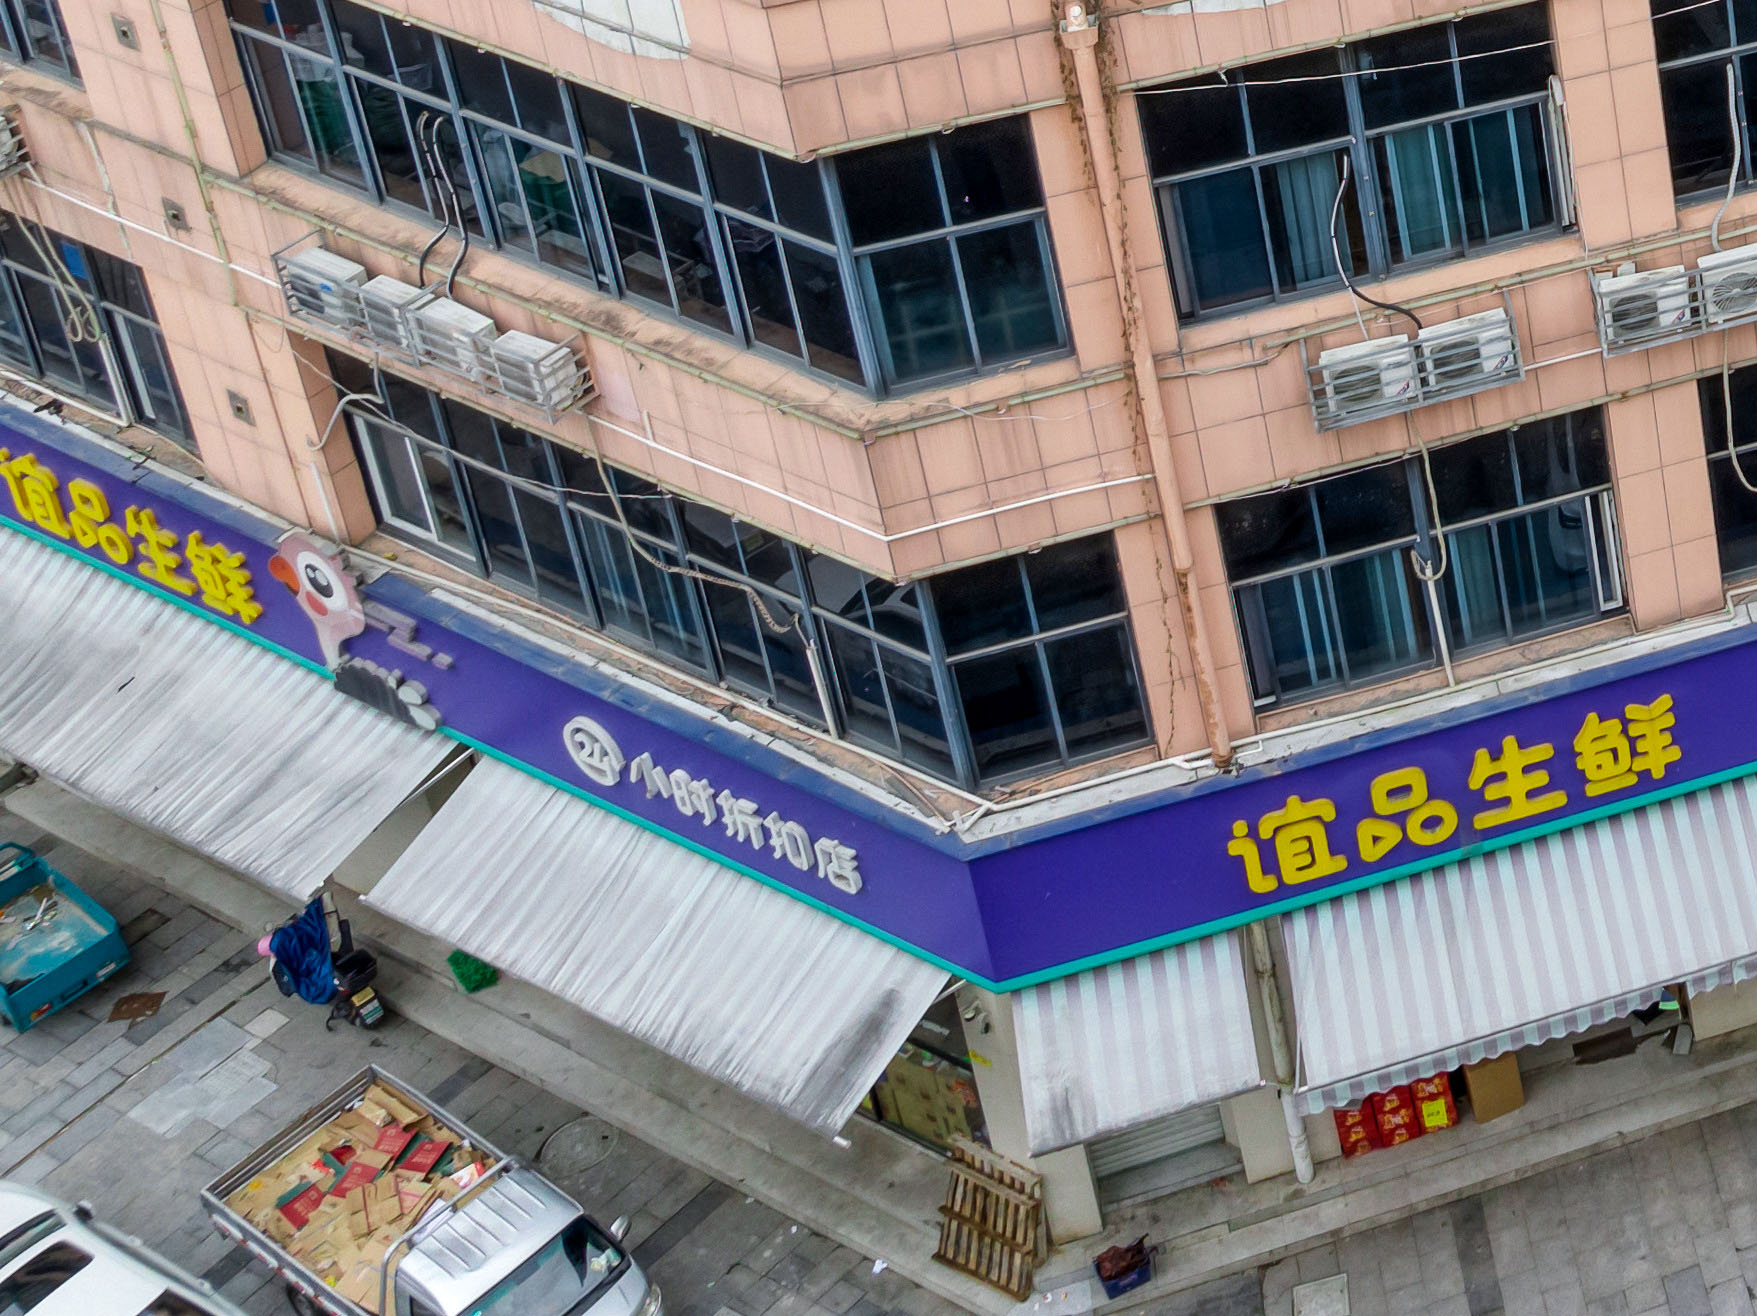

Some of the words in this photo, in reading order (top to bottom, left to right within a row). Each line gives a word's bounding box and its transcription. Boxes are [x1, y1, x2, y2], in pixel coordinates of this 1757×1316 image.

[0, 447, 264, 625] 谊品生鲜
[629, 751, 863, 895] 小时折扣店
[1227, 693, 1683, 895] 谊品生鲜
